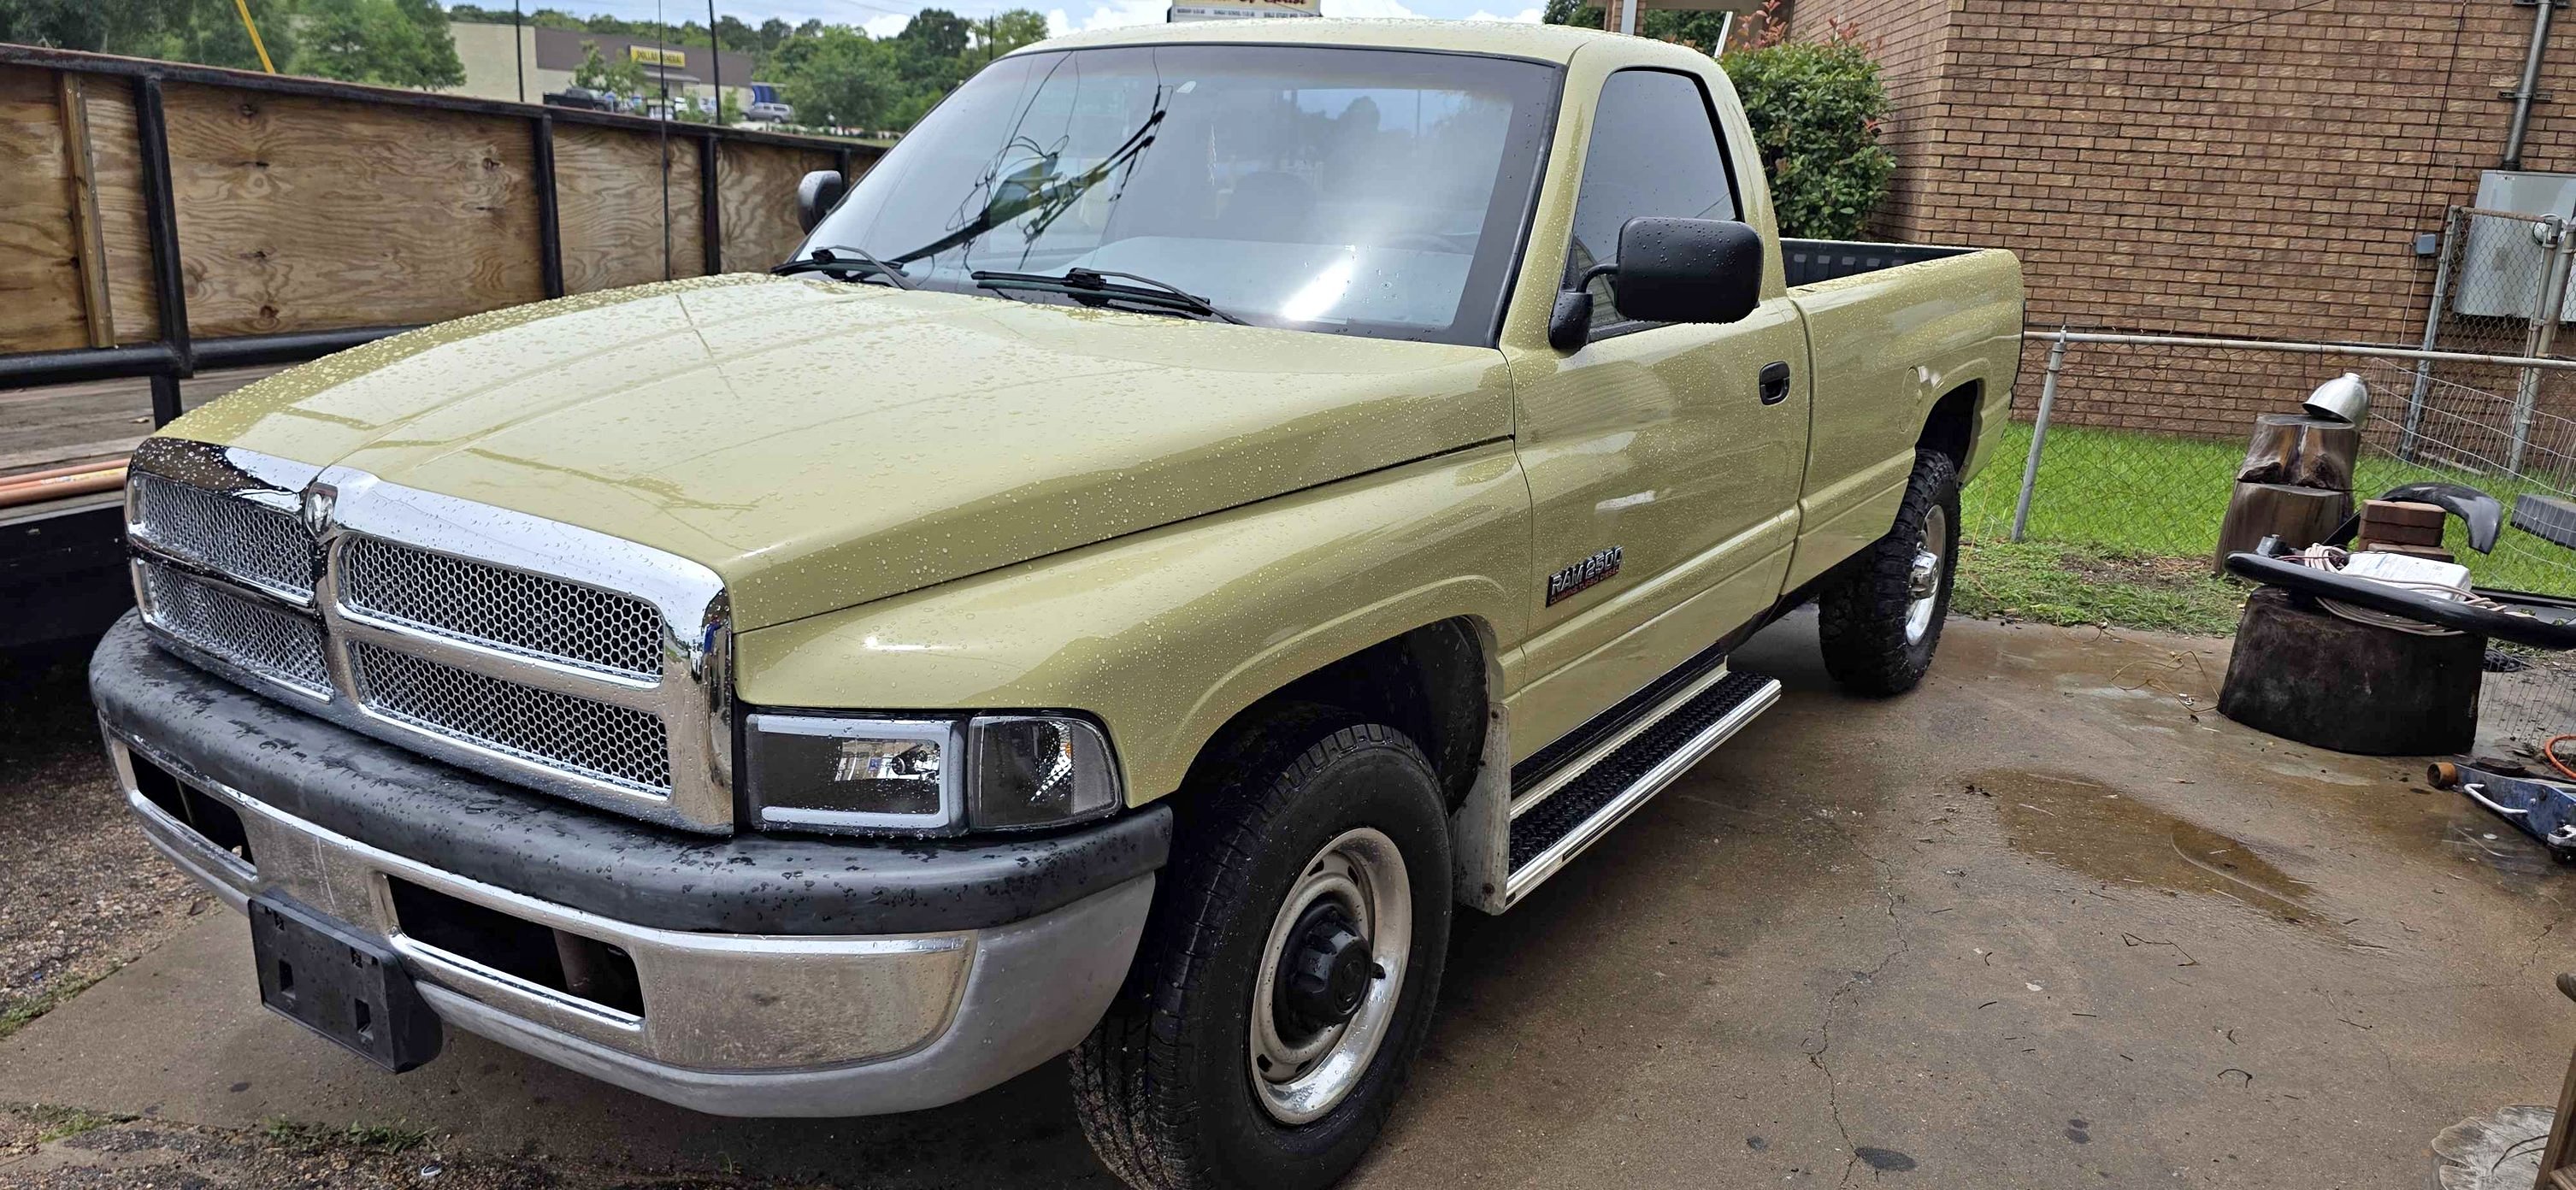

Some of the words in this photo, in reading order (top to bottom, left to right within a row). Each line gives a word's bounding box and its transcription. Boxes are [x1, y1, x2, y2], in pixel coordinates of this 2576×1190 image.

[1551, 565, 1584, 596] RAM
[1585, 546, 1624, 580] 2500
[1578, 577, 1599, 591] TURBO
